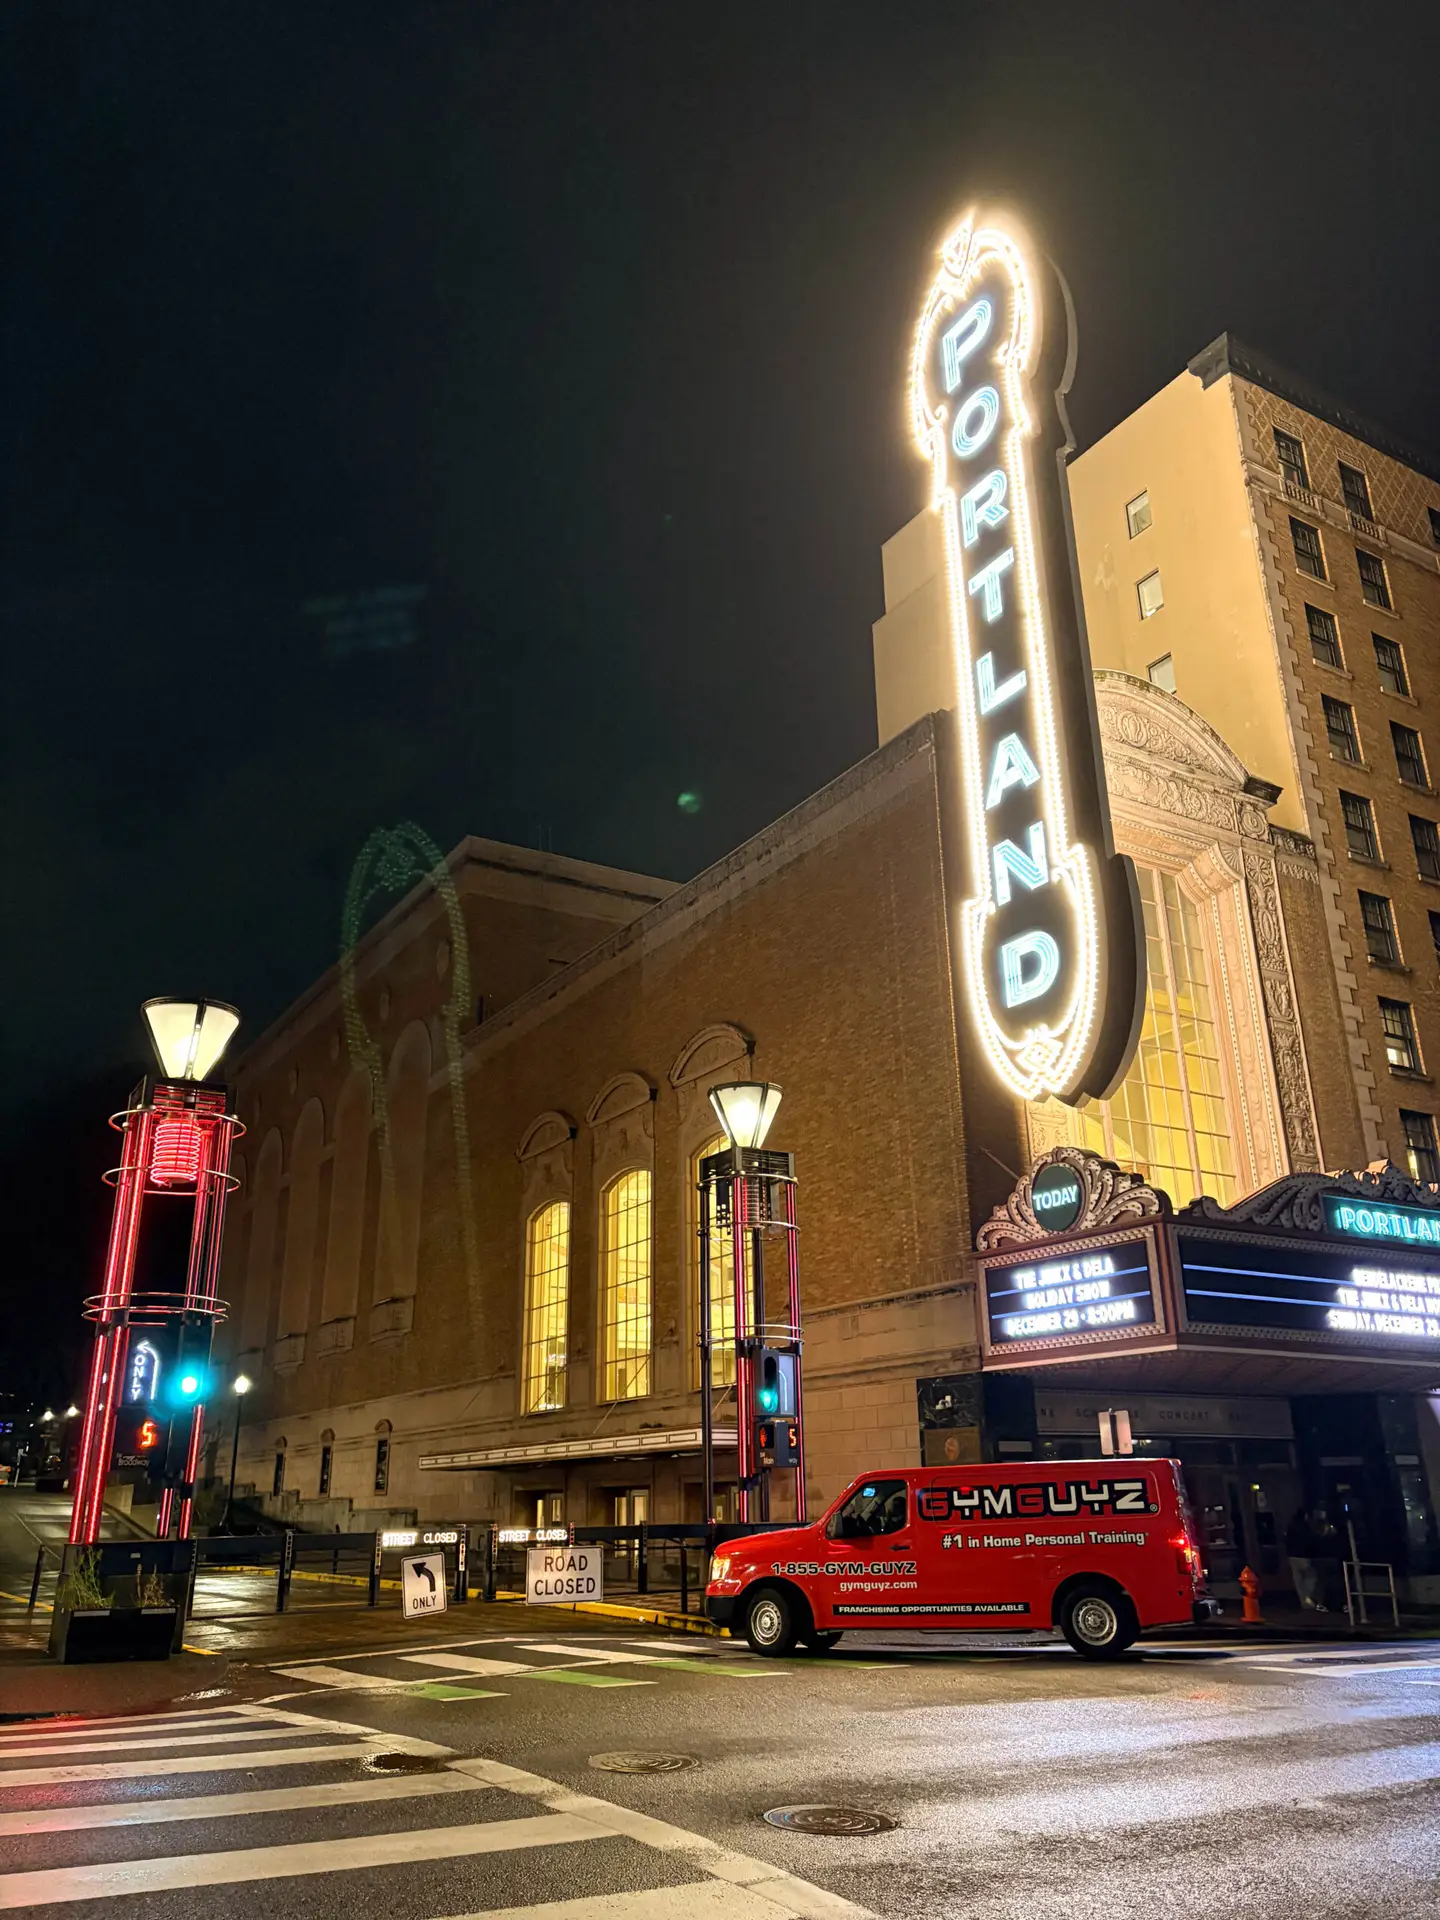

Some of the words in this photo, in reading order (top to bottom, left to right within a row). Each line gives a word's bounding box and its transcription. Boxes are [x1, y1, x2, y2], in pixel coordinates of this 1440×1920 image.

[942, 299, 1060, 1009] PORTLAND
[1033, 1185, 1078, 1211] TODAY
[132, 1354, 146, 1401] ONLY
[141, 1421, 157, 1447] 5
[788, 1428, 797, 1447] 5
[918, 1479, 1149, 1521] GYMGUYZ
[382, 1531, 418, 1546] STREET
[423, 1532, 458, 1543] CLOSED
[499, 1530, 531, 1542] STREET
[536, 1529, 568, 1541] CLOSED
[942, 1534, 964, 1549] #1
[968, 1536, 980, 1548] in
[983, 1534, 1022, 1547] Home
[1026, 1532, 1086, 1546] Personal
[1089, 1531, 1146, 1546] Training
[544, 1555, 588, 1572] ROAD
[771, 1561, 918, 1575] 1-855-GYM-GUYZ
[534, 1577, 596, 1596] CLOSED
[839, 1580, 918, 1592] gymguyz.com
[412, 1595, 437, 1610] ONLY
[901, 1605, 973, 1613] OPPORTUNITIES
[974, 1604, 1025, 1612] AVAILABLE
